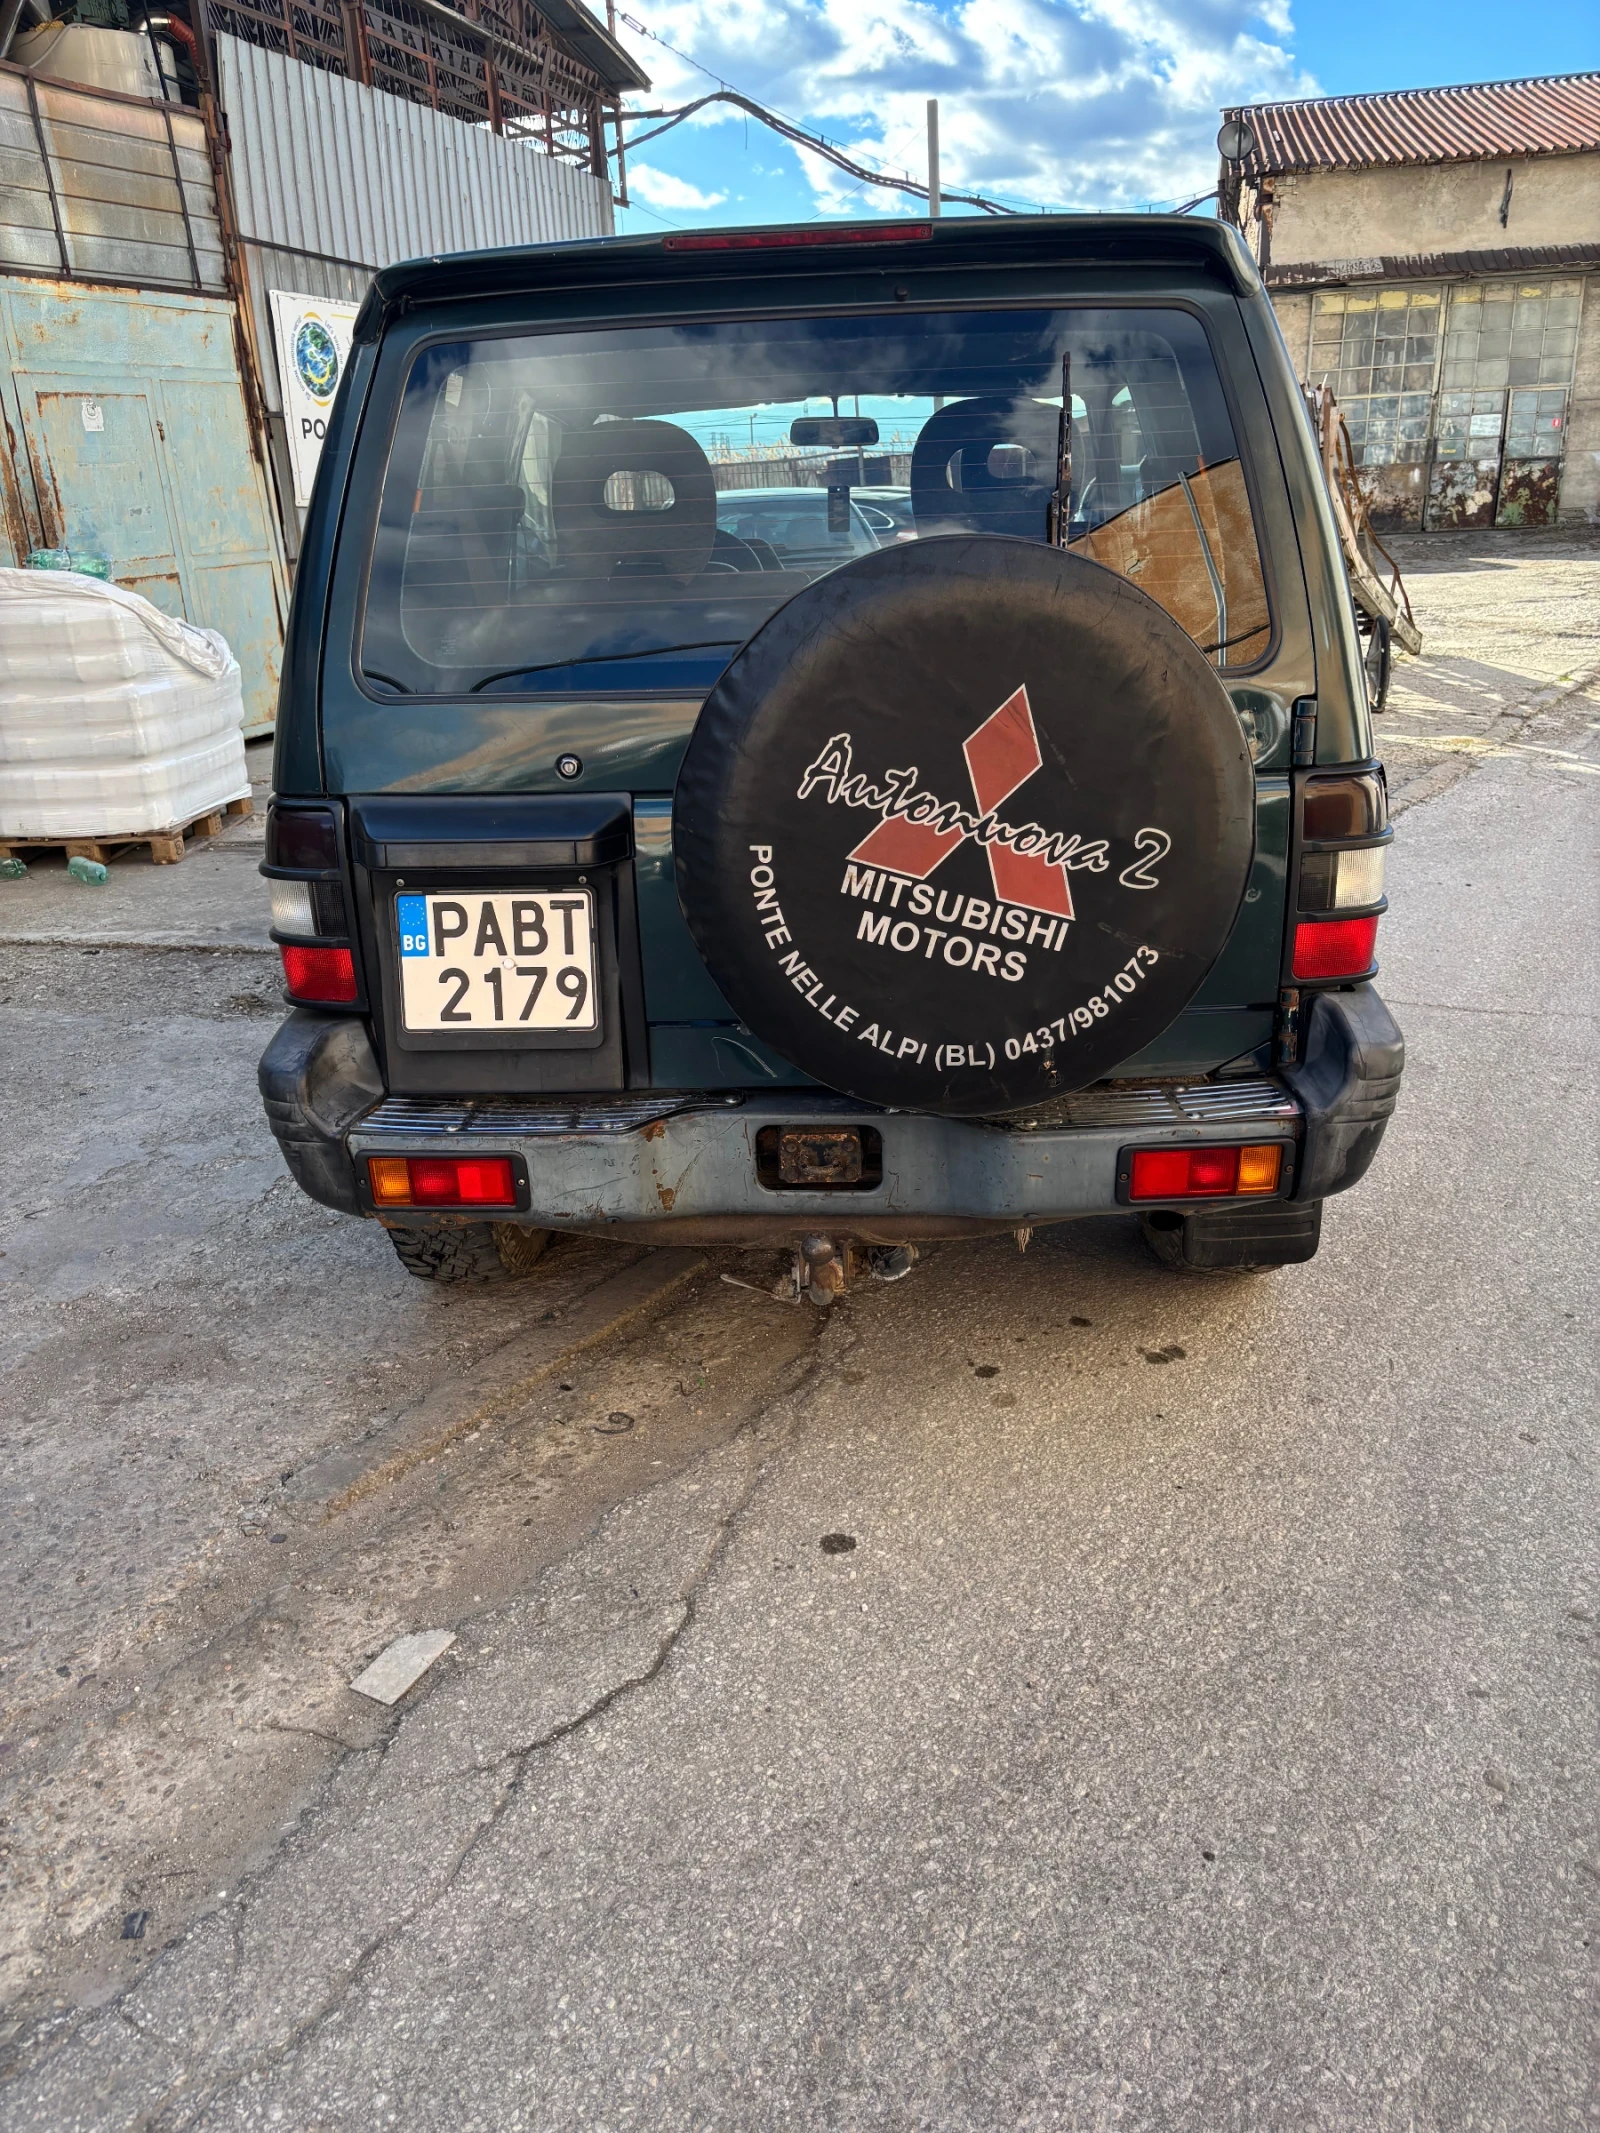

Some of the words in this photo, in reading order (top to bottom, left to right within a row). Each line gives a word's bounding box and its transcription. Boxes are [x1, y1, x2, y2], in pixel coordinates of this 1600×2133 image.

[1119, 828, 1172, 889] 2
[432, 899, 585, 957] PABT
[840, 864, 1070, 952] MITSUBISHI
[402, 934, 427, 952] BG
[749, 845, 793, 950] PONTE
[778, 950, 860, 1032] NELLE
[857, 1023, 928, 1065] ALPI
[934, 1042, 996, 1072] (BL)
[1004, 945, 1159, 1061] 0437/981073
[856, 910, 1028, 982] MOTORS
[438, 965, 588, 1022] 2179
